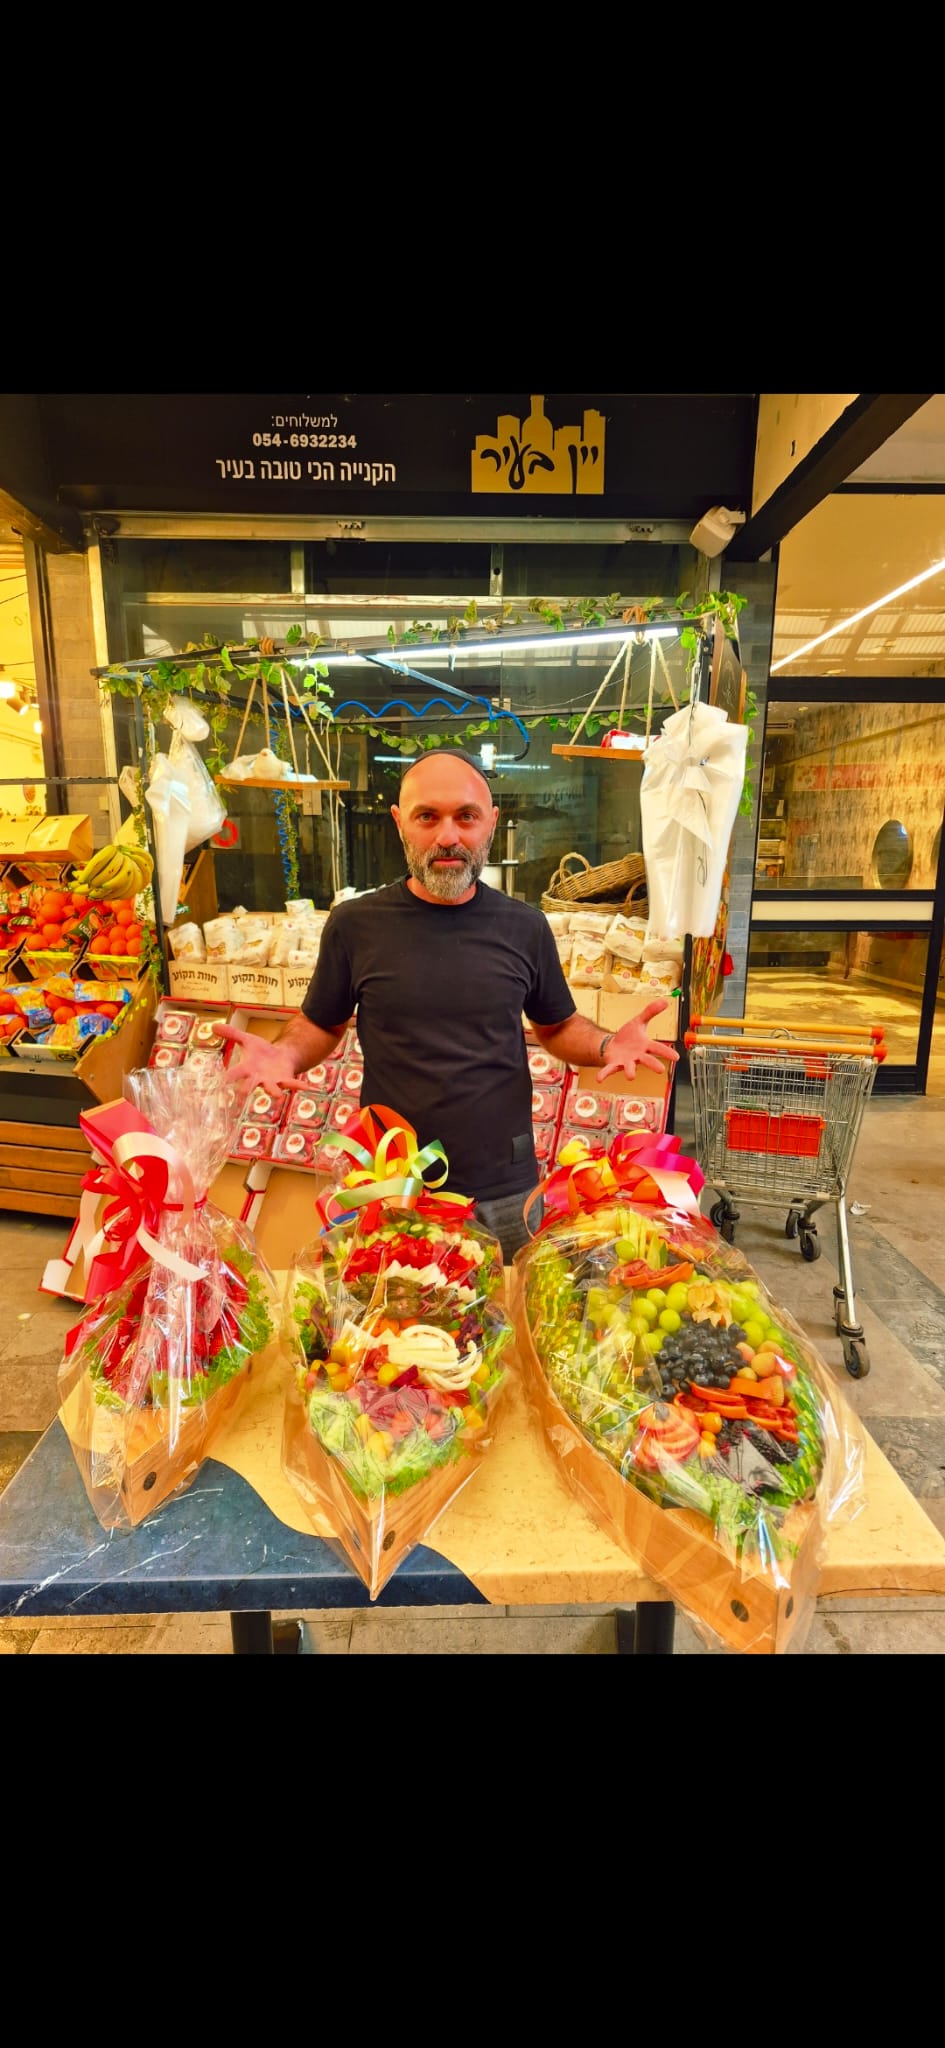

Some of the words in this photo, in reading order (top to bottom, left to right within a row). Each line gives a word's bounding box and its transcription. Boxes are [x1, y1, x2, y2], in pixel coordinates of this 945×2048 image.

[271, 413, 338, 428] למשלוחים:
[252, 432, 358, 449] 054-6932234
[215, 459, 256, 479] בעיר
[260, 460, 302, 480] טובה
[307, 461, 334, 481] הכי
[480, 435, 555, 490] בעיר
[567, 444, 599, 494] יין
[340, 461, 396, 486] הקנייה
[172, 969, 196, 983] תקוע
[197, 971, 218, 984] חוות
[231, 973, 256, 985] תקוע
[257, 974, 279, 988] חוות
